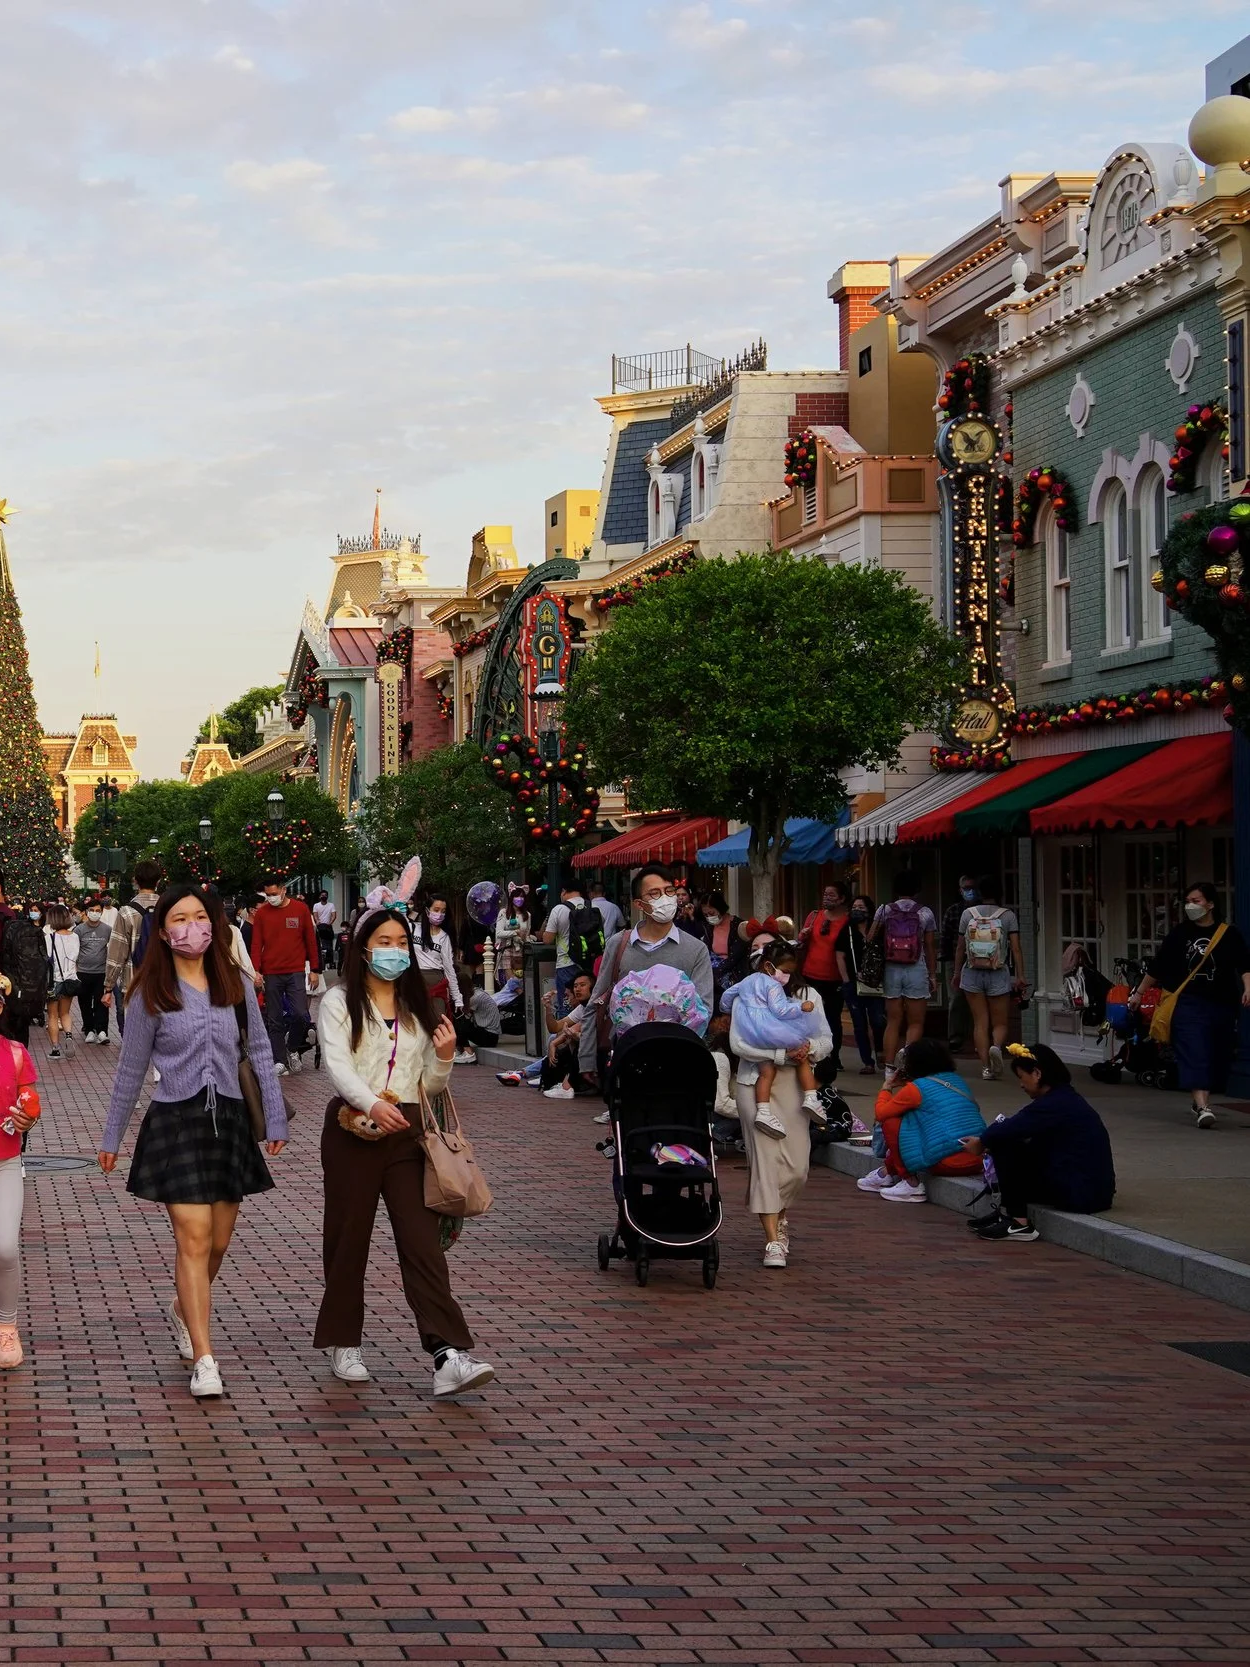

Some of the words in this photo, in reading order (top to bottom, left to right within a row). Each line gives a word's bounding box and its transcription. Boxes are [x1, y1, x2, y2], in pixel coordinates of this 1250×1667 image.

[1121, 201, 1138, 231] 1876
[967, 474, 988, 686] CENTENNIAL
[386, 681, 395, 719] GOODS
[387, 735, 395, 765] FINE
